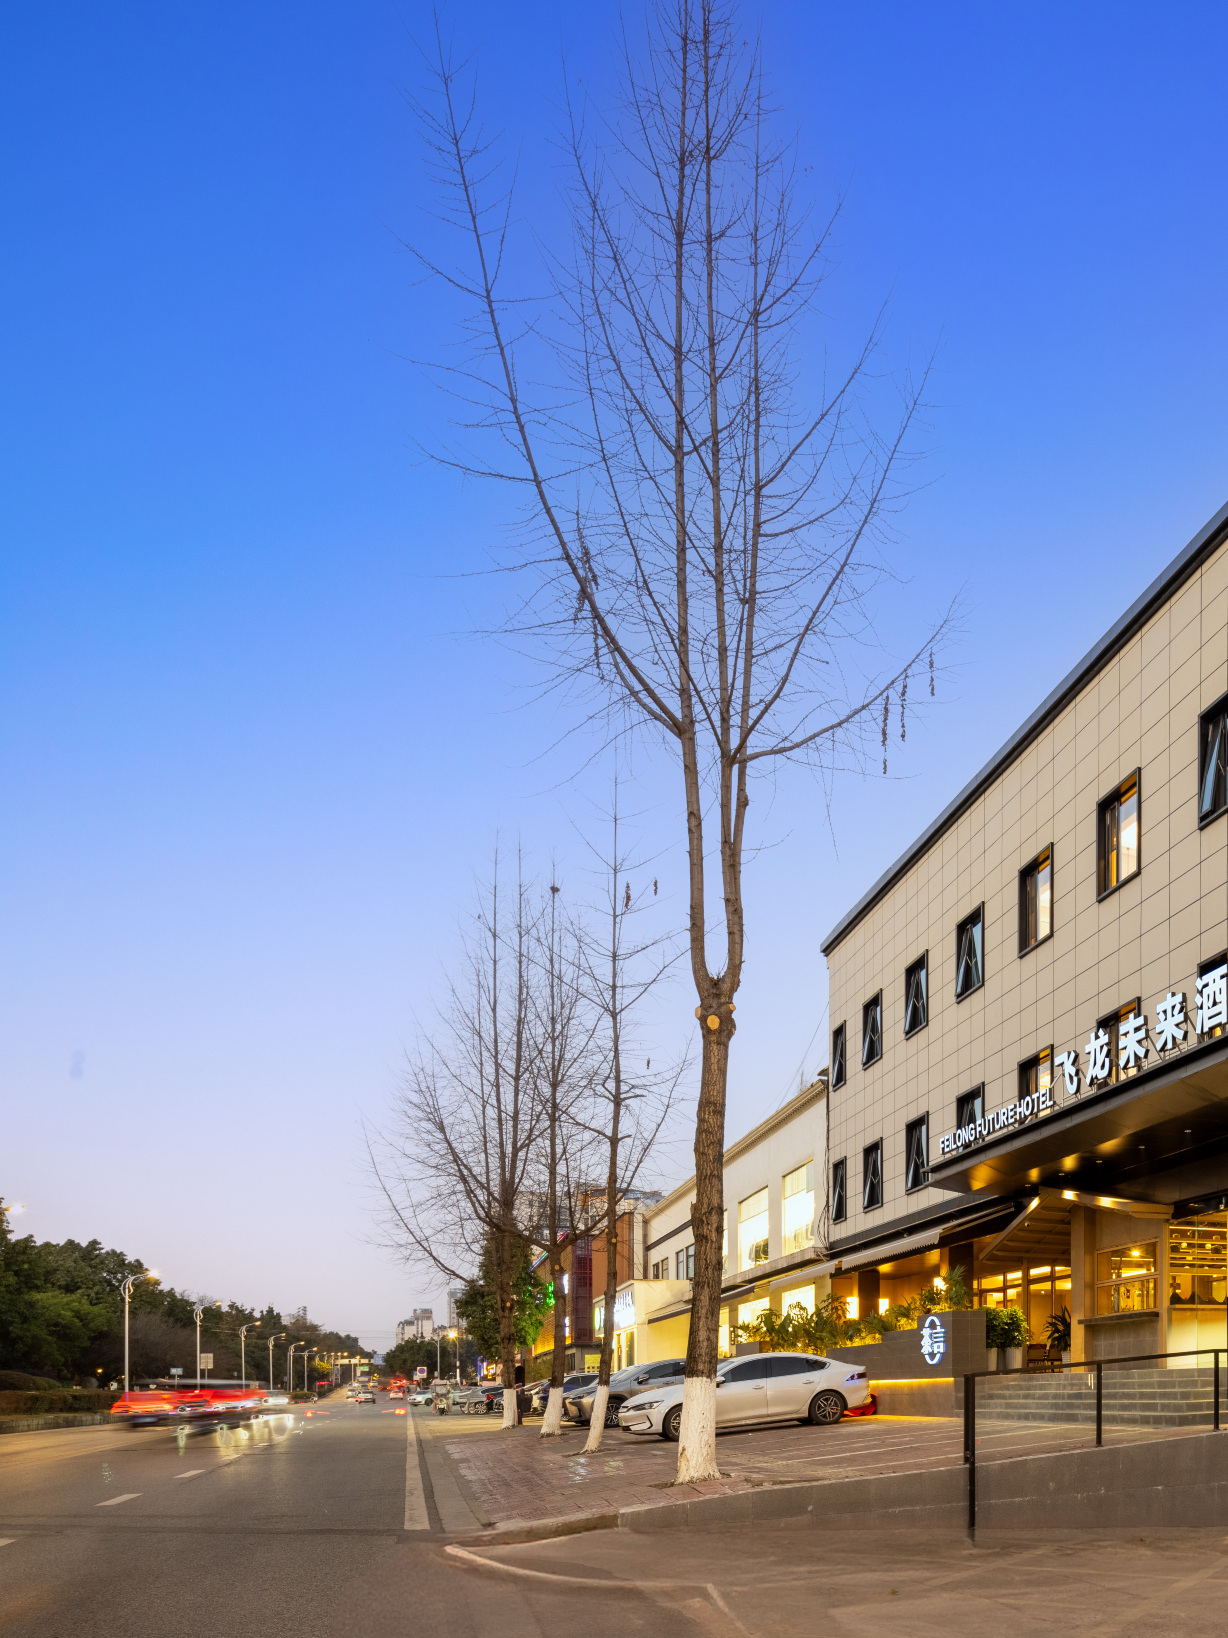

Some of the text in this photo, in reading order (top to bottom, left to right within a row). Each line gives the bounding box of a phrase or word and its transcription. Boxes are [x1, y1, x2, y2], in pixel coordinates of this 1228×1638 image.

[939, 1087, 1054, 1155] FEILONG FUTURE HOTEL
